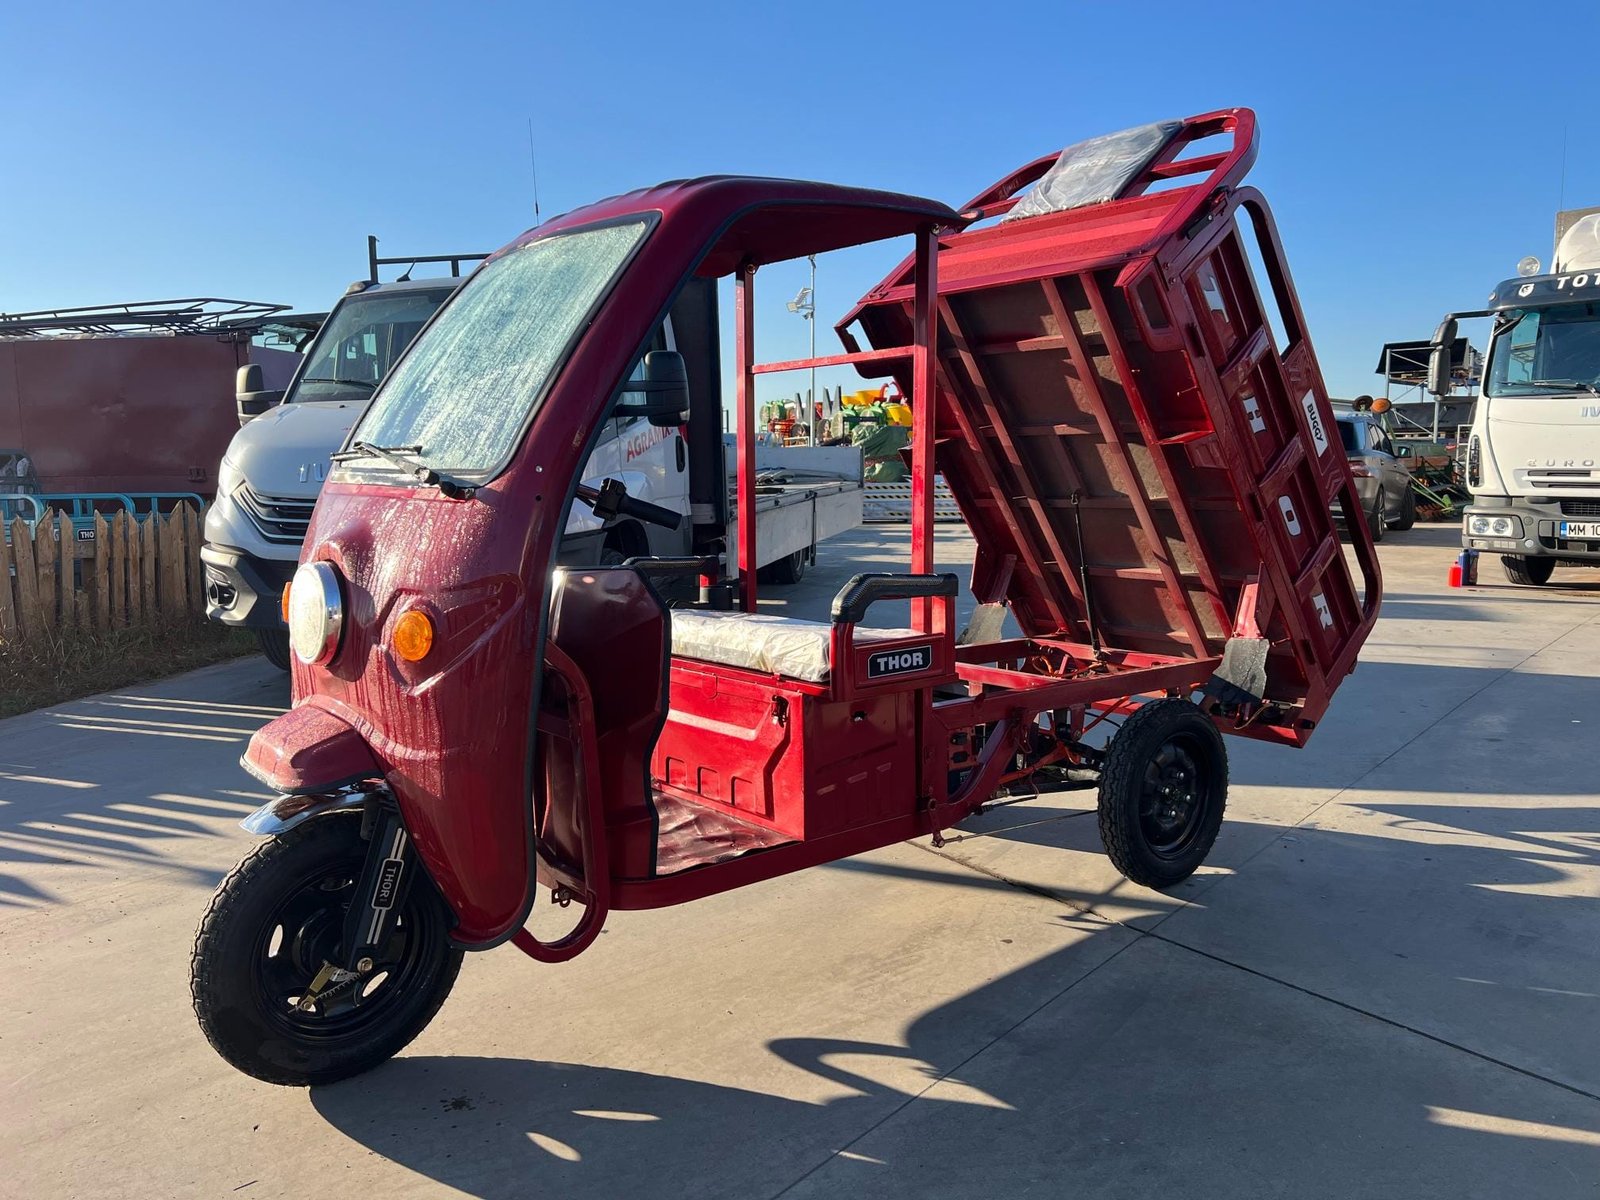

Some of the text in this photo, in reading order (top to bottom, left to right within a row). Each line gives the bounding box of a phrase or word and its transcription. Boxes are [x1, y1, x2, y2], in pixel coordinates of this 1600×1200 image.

[1306, 403, 1324, 442] BUGGY
[80, 530, 95, 540] THO
[1568, 525, 1586, 536] MM
[876, 652, 924, 672] THOR
